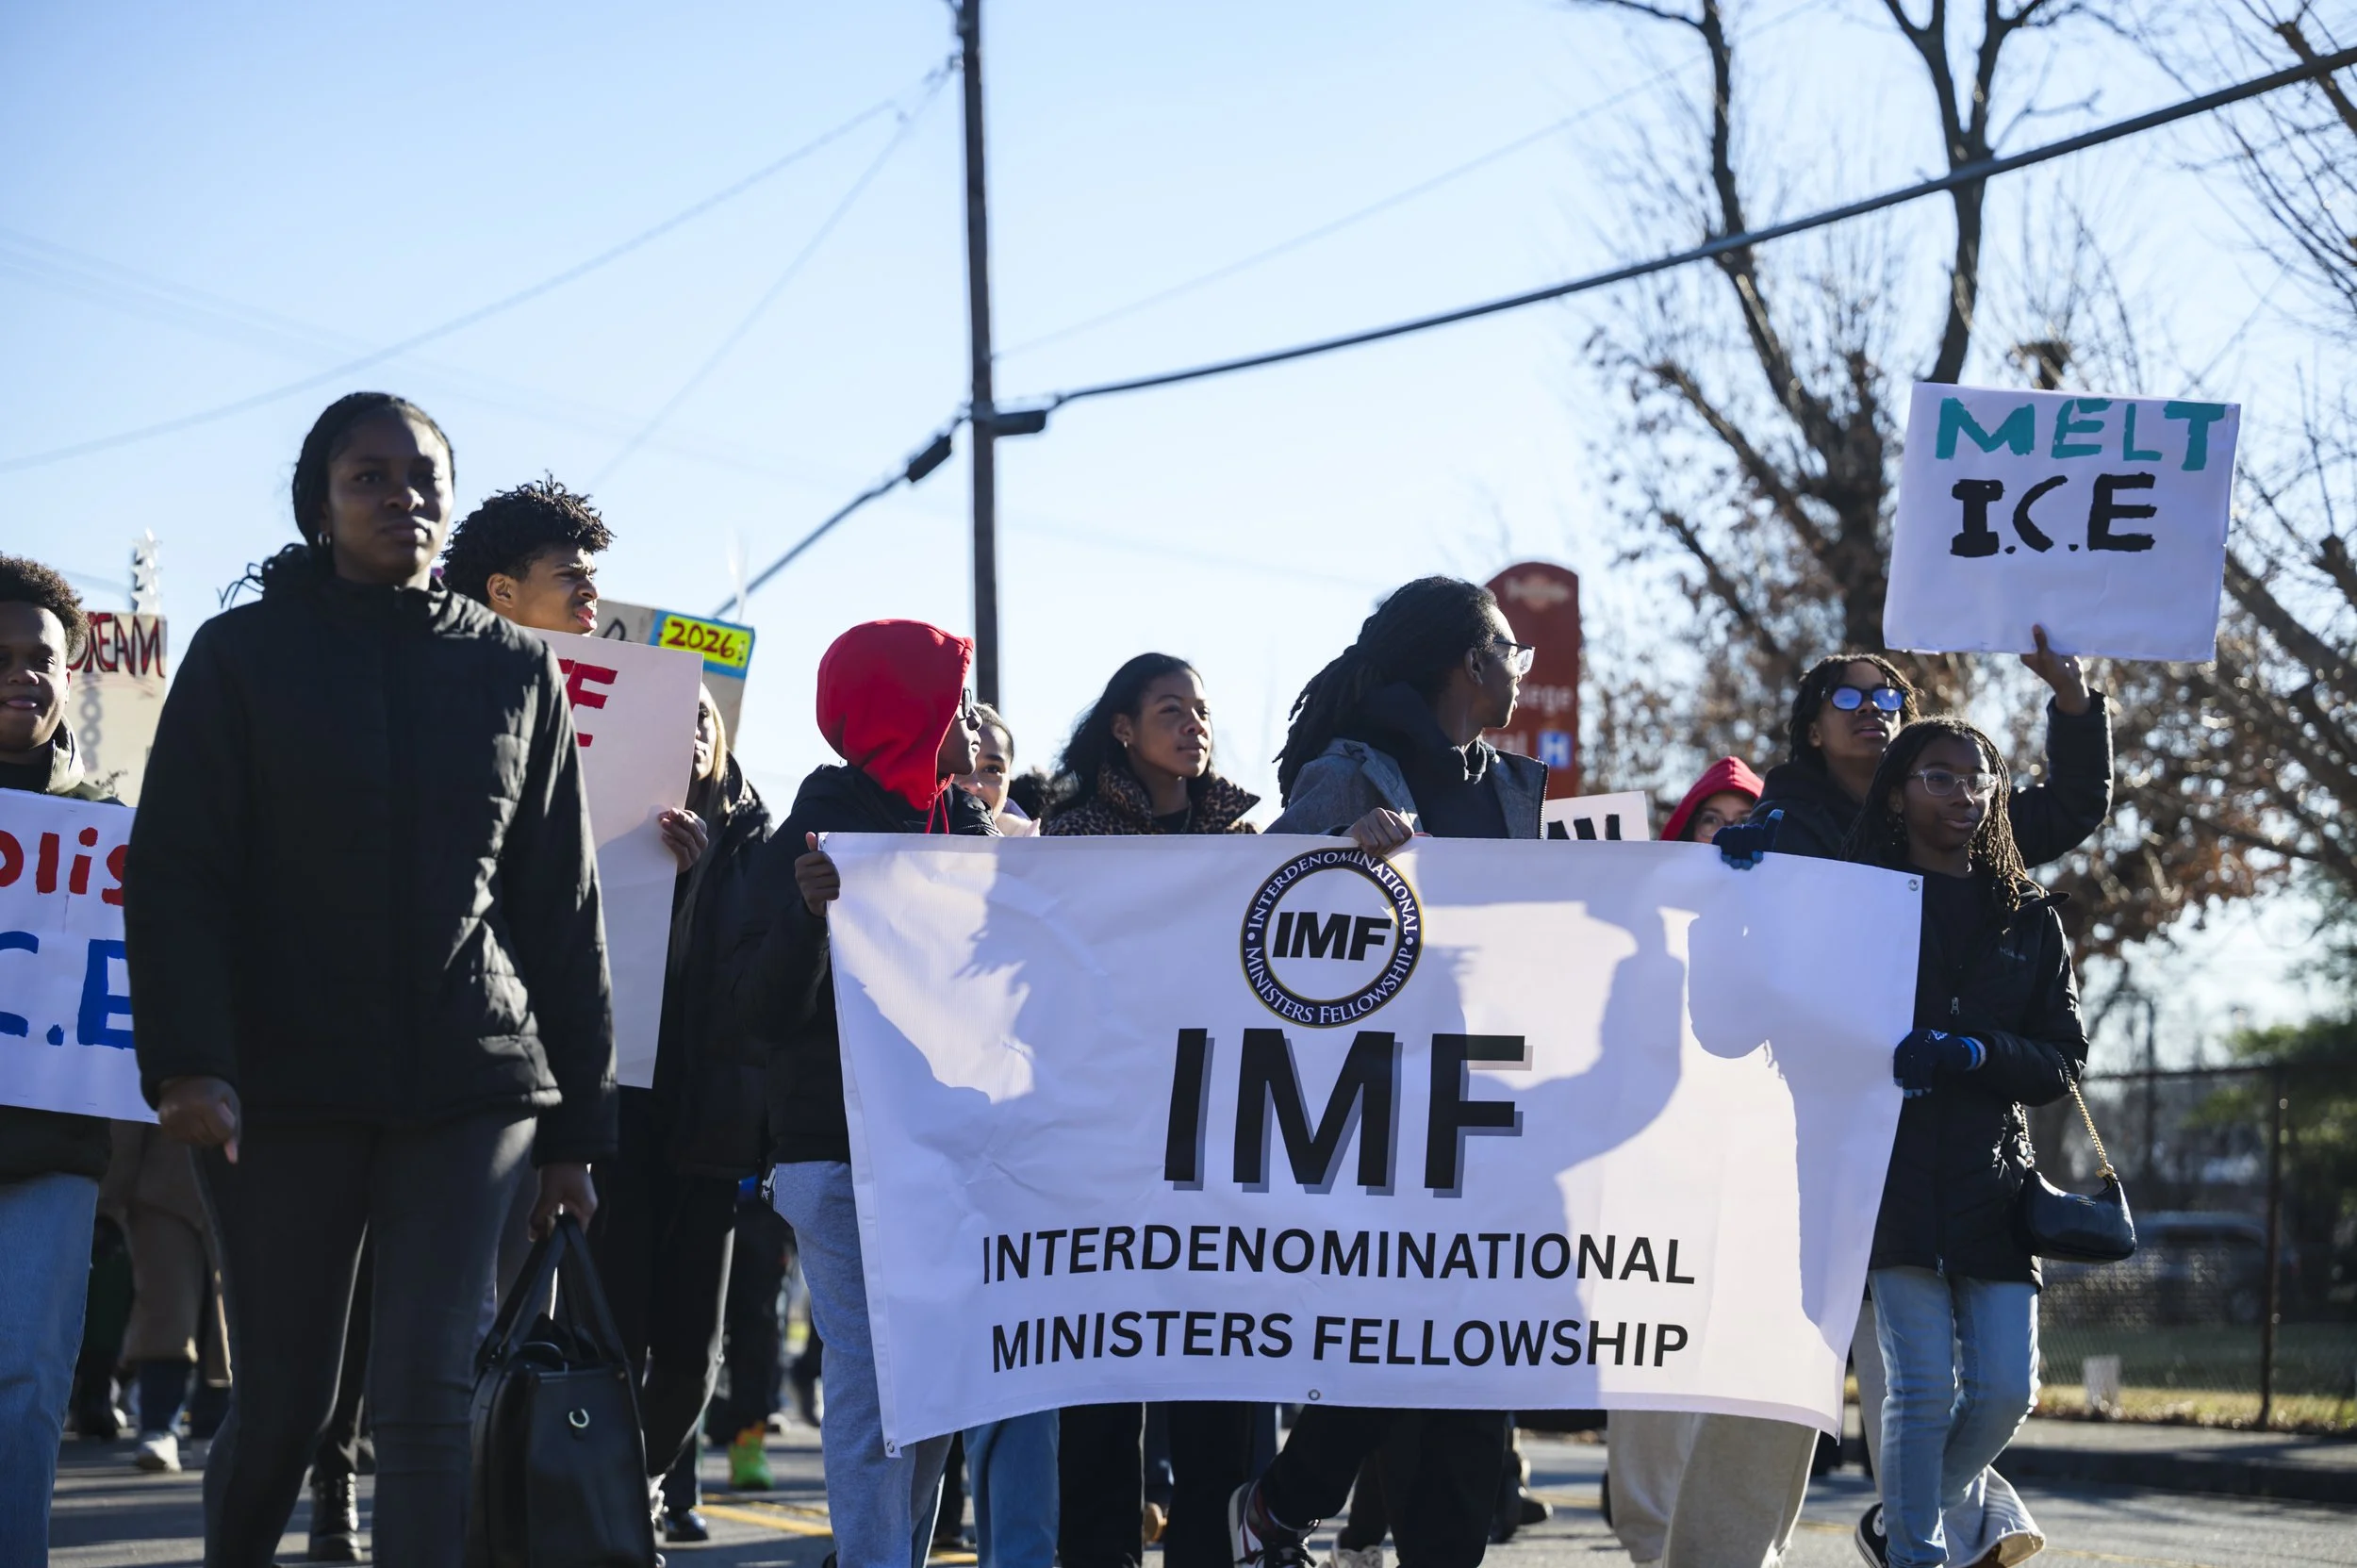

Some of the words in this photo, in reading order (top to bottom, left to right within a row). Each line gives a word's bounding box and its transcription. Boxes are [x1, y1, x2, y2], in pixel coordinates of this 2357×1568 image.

[1936, 397, 2225, 470] MELT
[1950, 471, 2157, 557] I.C.E
[666, 620, 735, 659] 2026
[558, 658, 618, 748] E
[1247, 850, 1419, 935] INTERDENOMINATIONAL
[1273, 912, 1392, 961] IMF
[1246, 946, 1314, 1023] MINISTERS
[1320, 948, 1413, 1024] FELLOWSHIP
[1164, 1028, 1525, 1190] IMF
[983, 1225, 1695, 1285] INTERDENOMINATIONAL
[992, 1311, 1293, 1373] MINISTERS
[1314, 1316, 1688, 1368] FELLOWSHIP
